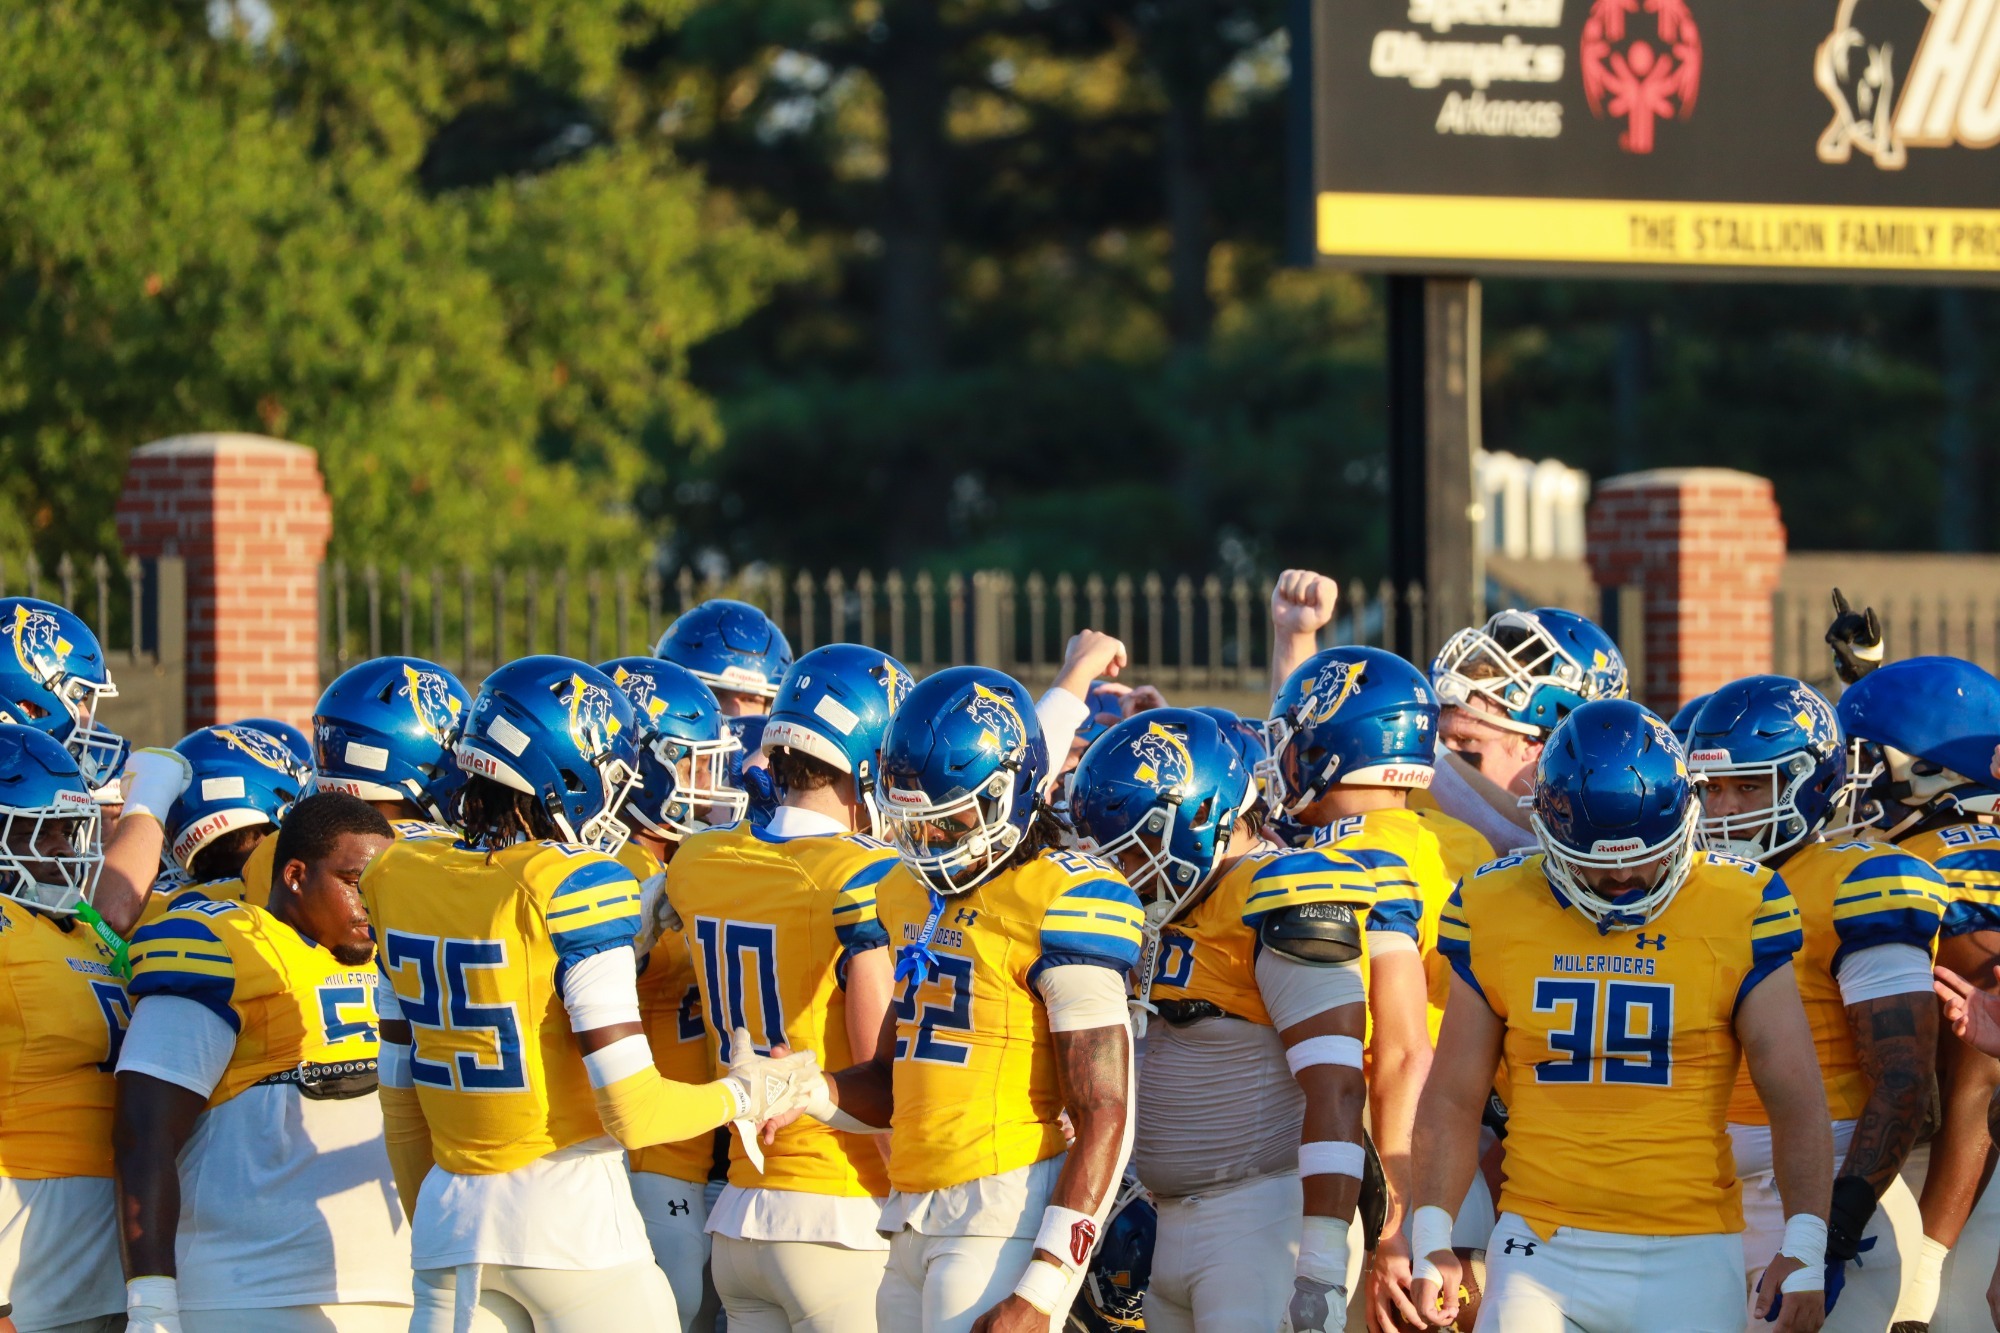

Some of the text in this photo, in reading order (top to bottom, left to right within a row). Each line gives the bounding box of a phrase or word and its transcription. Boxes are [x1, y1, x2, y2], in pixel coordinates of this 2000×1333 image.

[1370, 31, 1565, 88] Olympics
[1436, 91, 1563, 138] Arkansas
[1630, 213, 1676, 249] THE
[1693, 217, 1825, 251] STALLION
[1840, 221, 1936, 256] FAMILY
[795, 674, 811, 690] 10
[476, 696, 491, 713] 25
[318, 726, 330, 741] 99
[1415, 714, 1429, 731] 92
[1692, 751, 1723, 761] Riddell
[61, 793, 90, 804] Riddell
[175, 813, 230, 860] Riddell
[1597, 842, 1639, 852] Riddell
[96, 921, 122, 949] NXTRND
[918, 913, 937, 944] NXTRND
[1553, 954, 1656, 976] MULERIDERS
[694, 914, 789, 1064] 10
[385, 927, 530, 1092] 25
[1534, 977, 1675, 1086] 39
